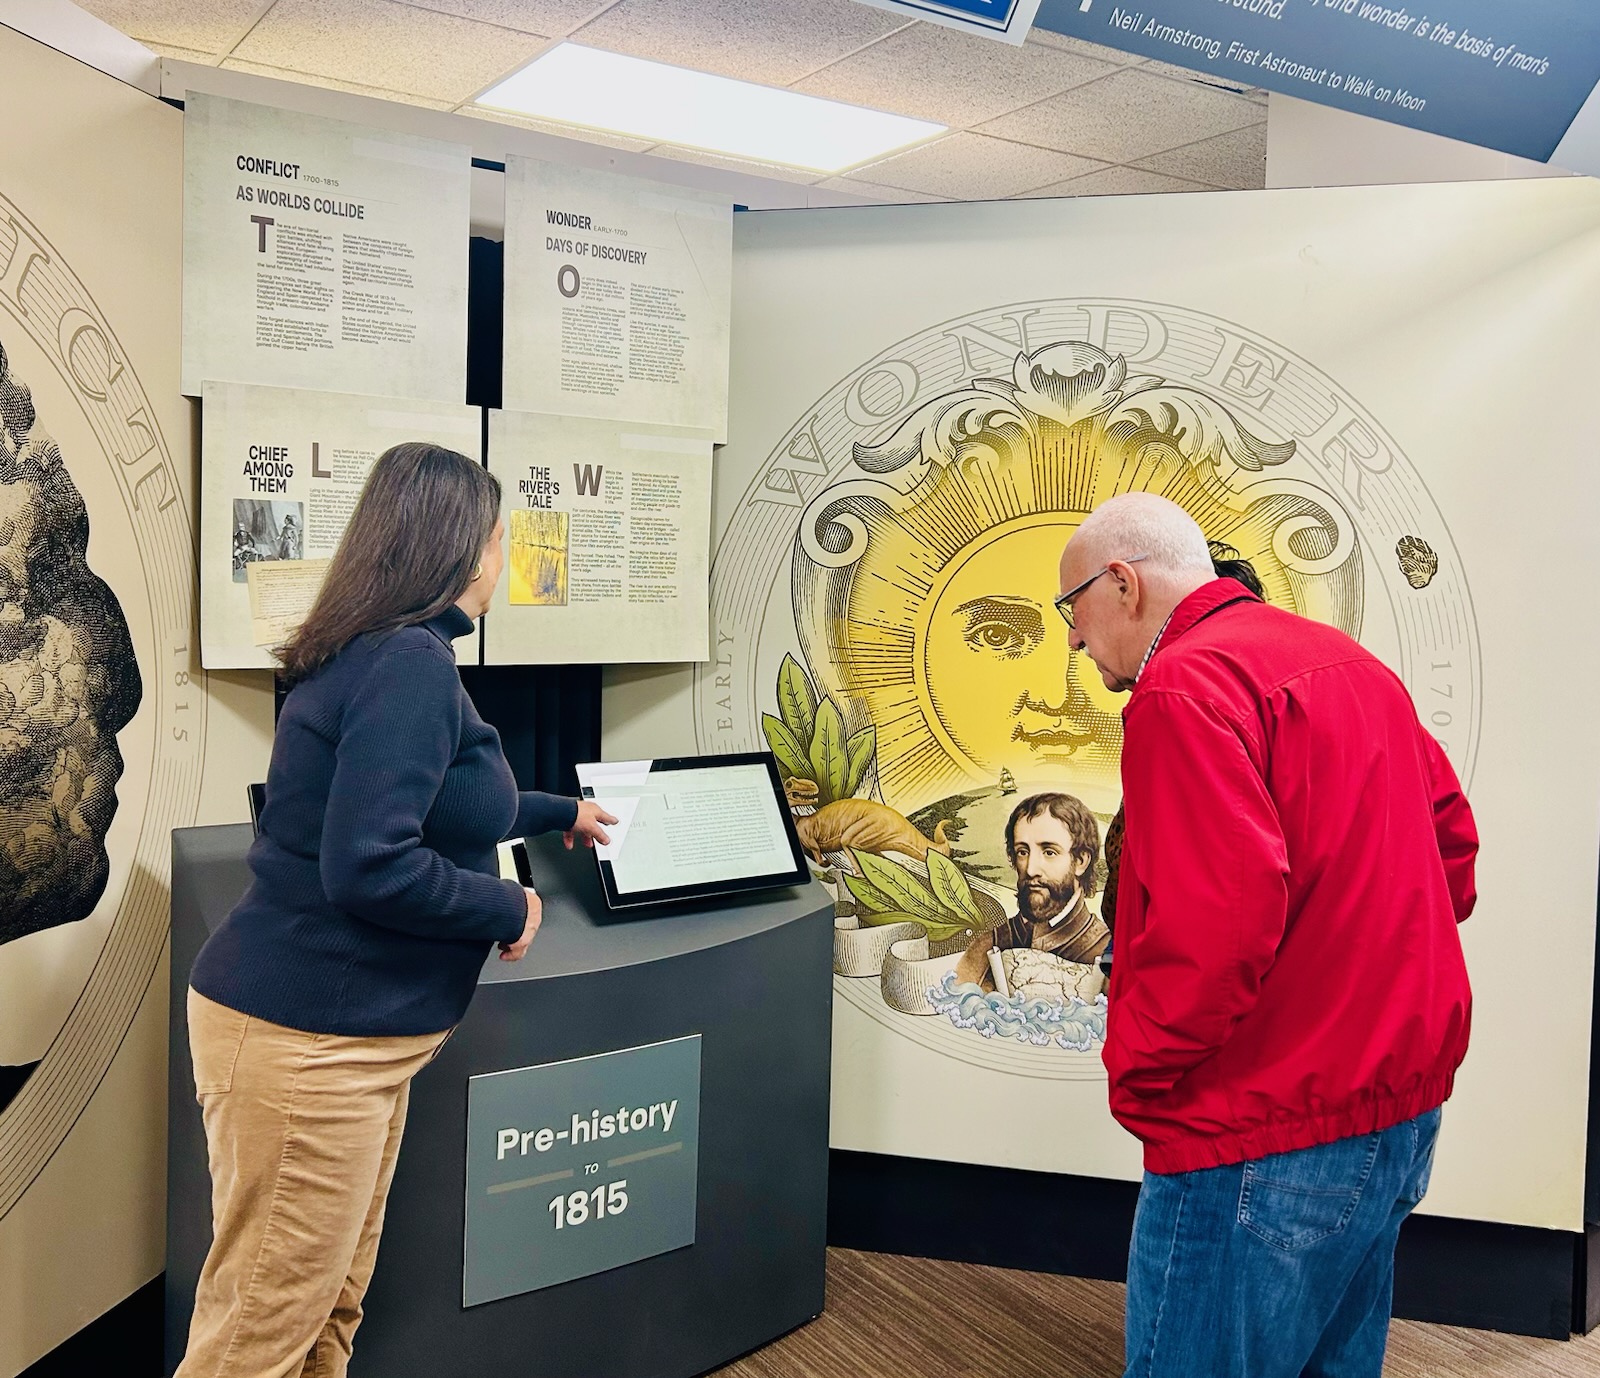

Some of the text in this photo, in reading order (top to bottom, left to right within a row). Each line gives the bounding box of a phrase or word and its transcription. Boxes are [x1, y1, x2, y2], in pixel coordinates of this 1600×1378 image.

[1357, 2, 1416, 32] wonder
[1413, 15, 1430, 37] is
[1429, 22, 1457, 46] the
[1454, 29, 1495, 58] basis
[1493, 44, 1517, 67] of
[1508, 54, 1550, 77] man's
[1108, 8, 1427, 112] Neil Armstrong, First Astronaut to Walk on Moon
[236, 154, 340, 187] CONFLICT 1700-1815
[236, 185, 365, 220] AS WORLDS COLLIDE
[546, 209, 628, 237] WONDER EARLY-1700
[546, 236, 648, 265] DAYS OF DISCOVERY
[749, 304, 1395, 509] WONDER
[249, 445, 289, 462] CHIEF
[243, 461, 294, 478] AMONG
[249, 476, 287, 493] THEM
[529, 466, 551, 481] THE
[519, 480, 560, 496] RIVER'S
[526, 494, 552, 509] TALE
[173, 644, 189, 742] 1815
[715, 630, 735, 731] EARLY
[497, 1099, 678, 1161] Pre-history
[584, 1162, 599, 1175] TO
[548, 1180, 629, 1230] 1815
